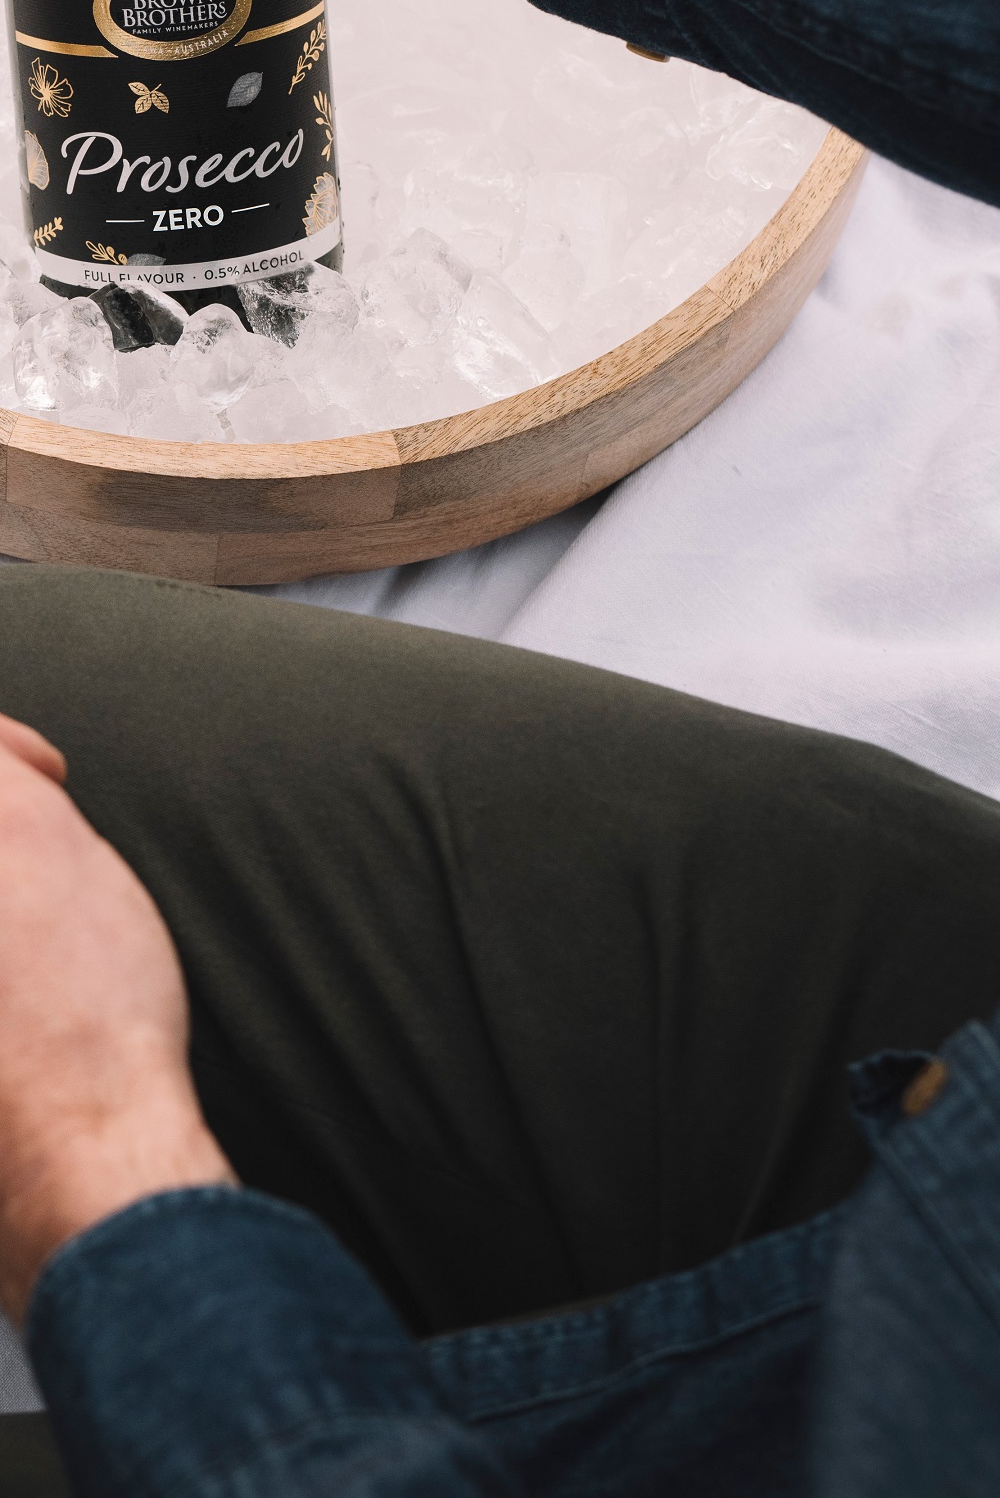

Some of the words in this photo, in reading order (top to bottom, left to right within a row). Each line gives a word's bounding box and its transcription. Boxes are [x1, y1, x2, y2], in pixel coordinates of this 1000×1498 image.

[121, 1, 228, 28] BROTHERS
[132, 27, 161, 35] FAMILY
[166, 21, 219, 32] WINEMAKERS
[174, 30, 229, 55] AUSTRALIA
[61, 128, 304, 195] Prosecco
[152, 204, 224, 232] ZERO
[84, 269, 114, 283] FULL
[204, 265, 239, 281] 0.5%
[242, 250, 305, 275] ALCOHOL
